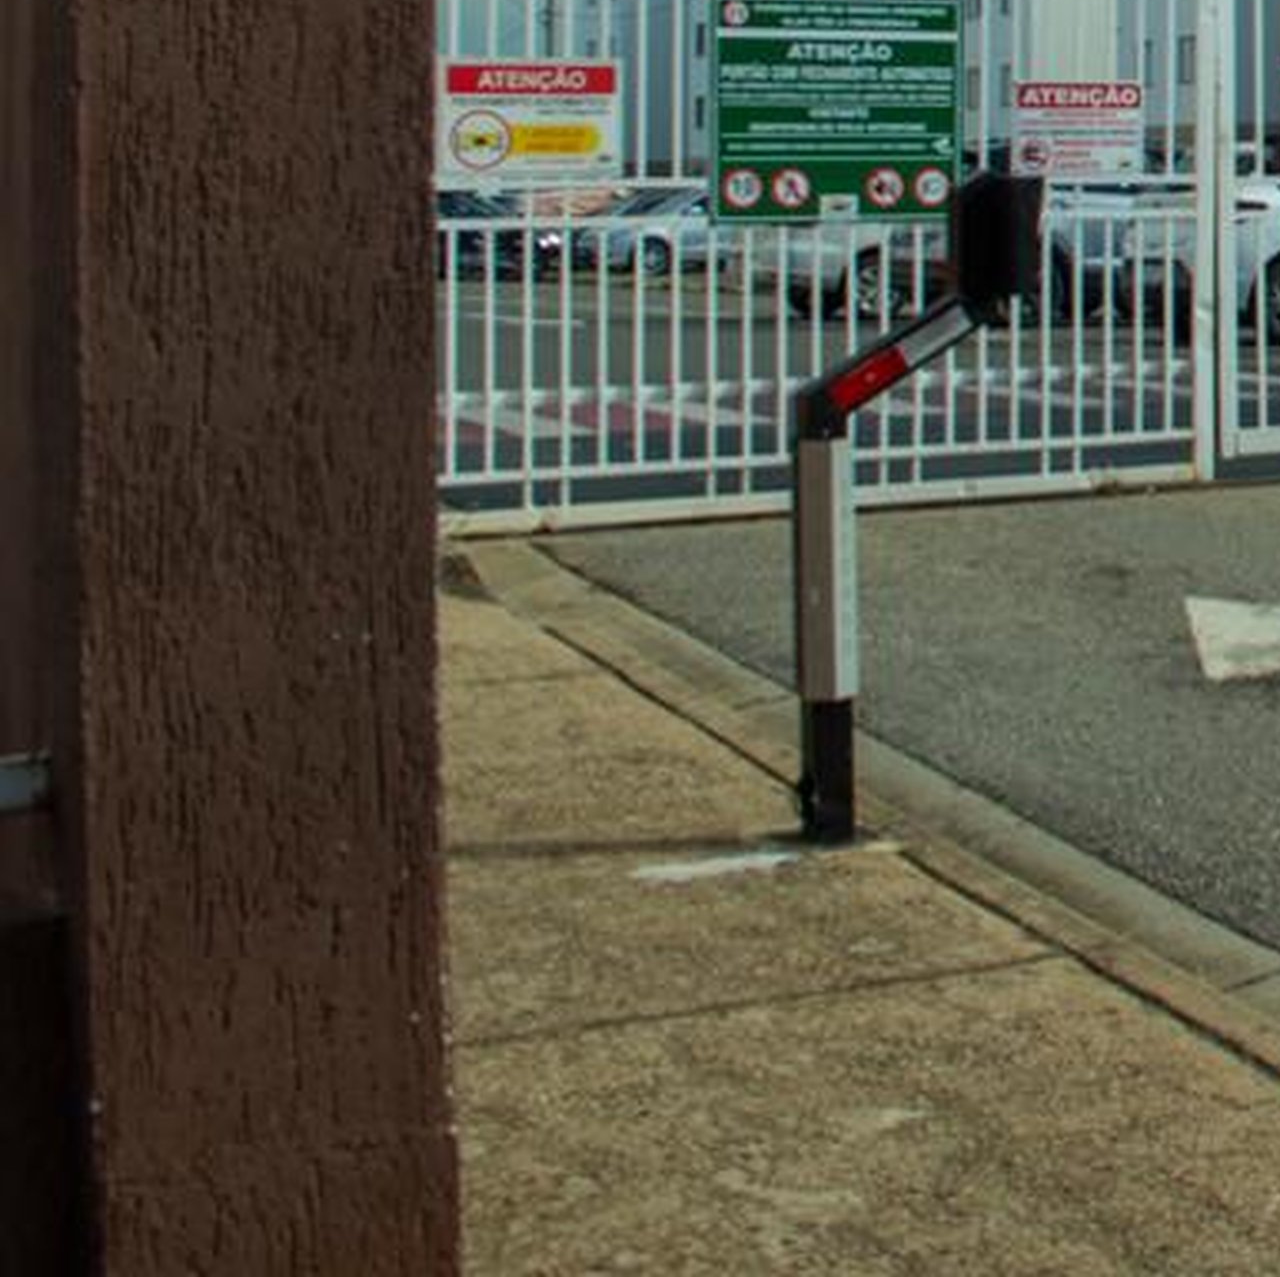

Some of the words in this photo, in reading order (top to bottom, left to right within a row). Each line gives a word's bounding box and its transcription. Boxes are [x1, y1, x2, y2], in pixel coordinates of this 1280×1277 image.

[787, 41, 893, 64] ATENÇÃO
[477, 65, 587, 90] ATENÇÃO
[1023, 84, 1138, 106] ATENÇÃO
